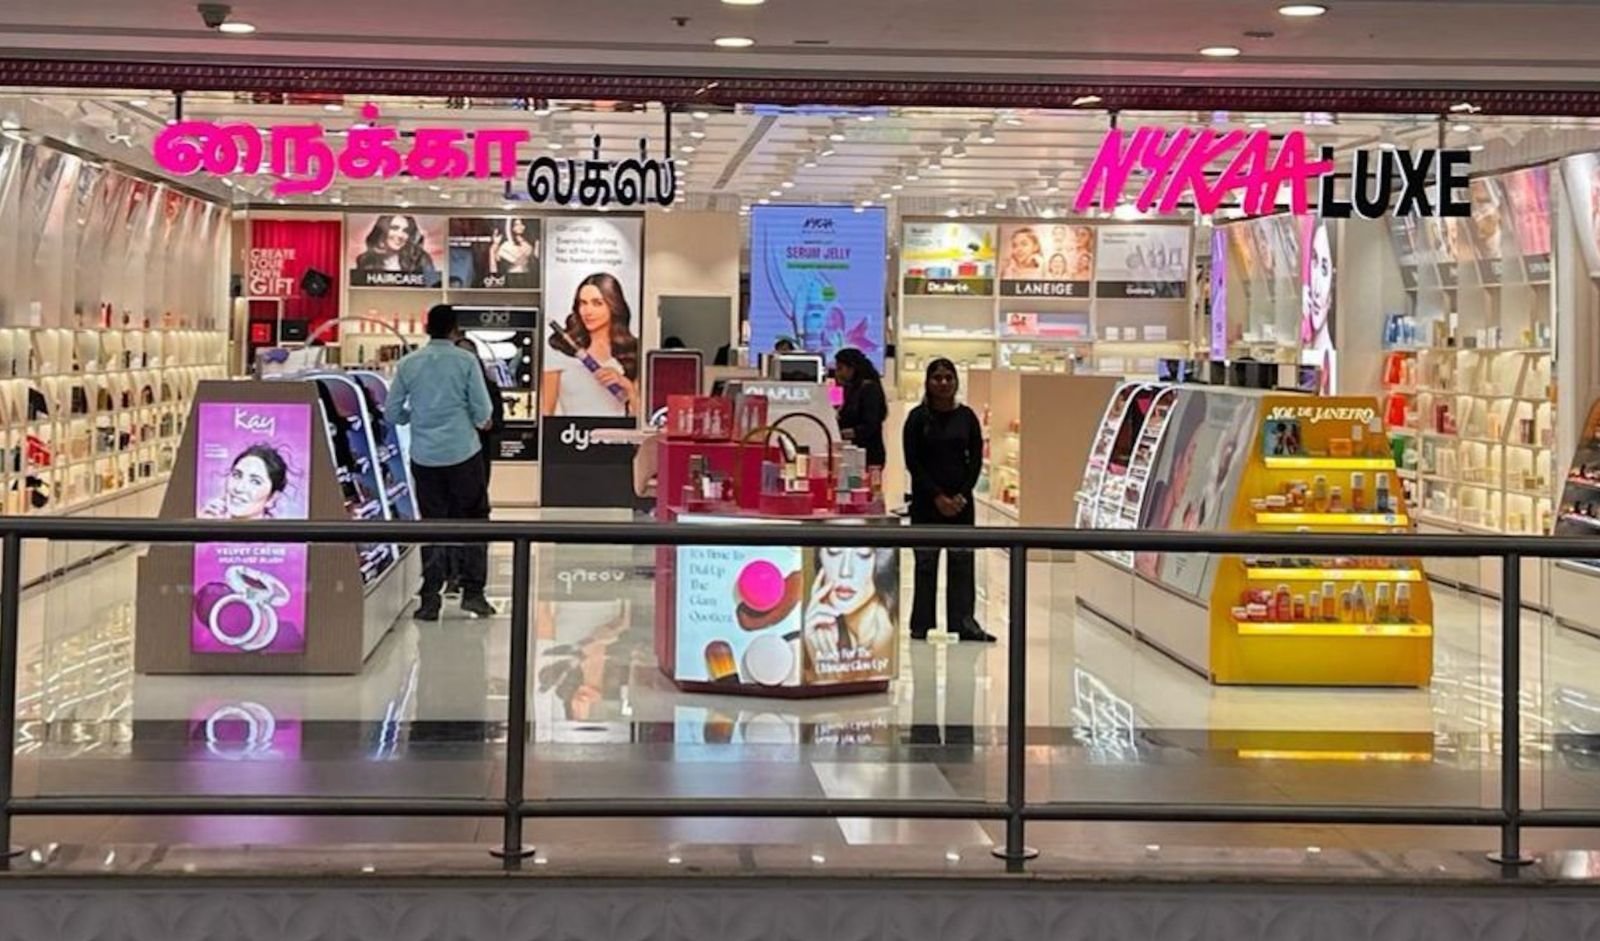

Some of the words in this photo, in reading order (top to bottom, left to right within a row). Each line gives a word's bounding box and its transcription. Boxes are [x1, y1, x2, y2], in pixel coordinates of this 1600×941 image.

[153, 102, 530, 197] நைக்கா
[527, 134, 678, 206] லக்ஸ்
[1073, 127, 1334, 216] NYKAA
[1318, 146, 1472, 220] LUXE
[250, 248, 297, 260] CREATE
[250, 259, 284, 269] YOUR
[250, 268, 281, 279] OWN
[366, 272, 424, 286] HAIRCARE
[250, 277, 295, 295] GIFT
[483, 274, 506, 288] ghd
[1015, 282, 1074, 296] LANEIGE
[234, 405, 276, 437] Kay
[1266, 406, 1297, 421] SOL
[1310, 406, 1376, 425] JANEIRO
